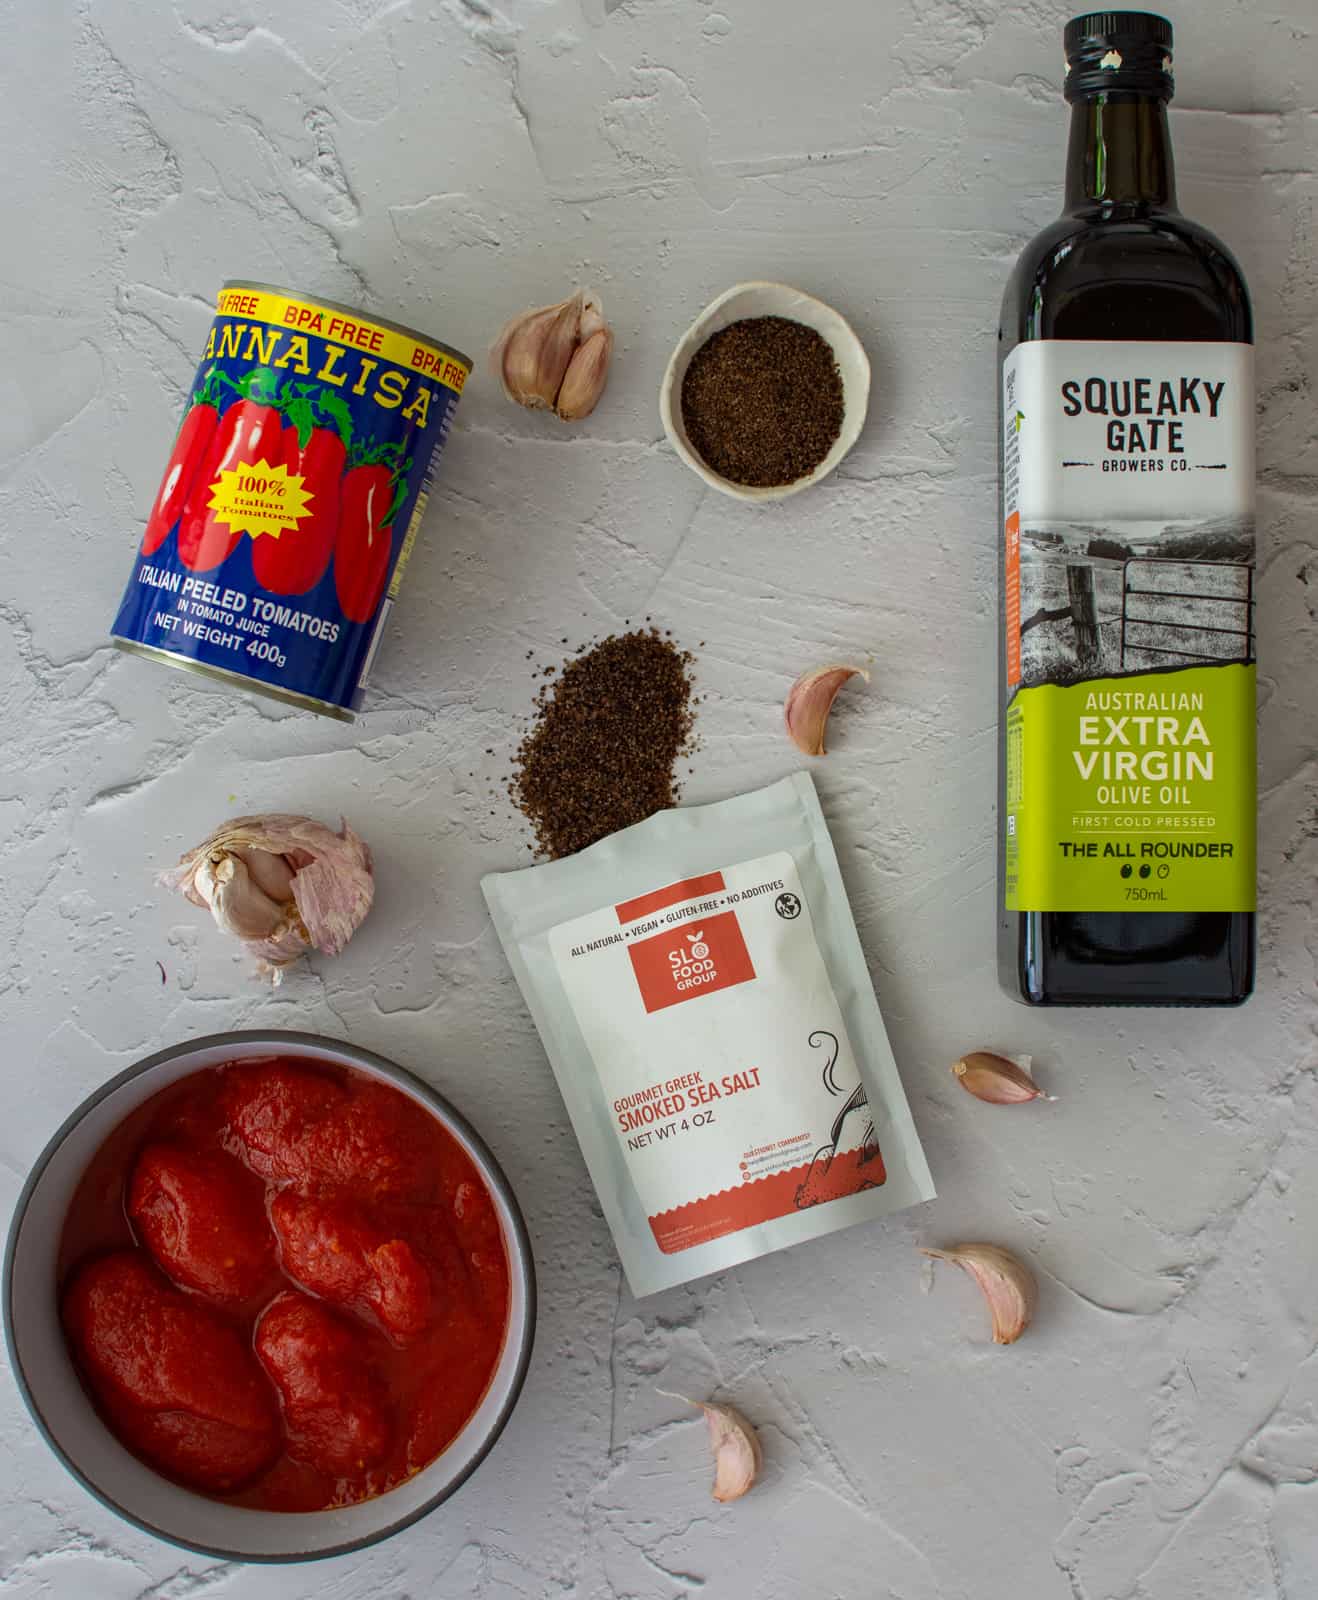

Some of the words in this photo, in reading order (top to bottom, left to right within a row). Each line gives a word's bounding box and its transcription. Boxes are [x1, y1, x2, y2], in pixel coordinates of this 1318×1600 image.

[225, 295, 259, 315] FREE
[283, 306, 322, 332] BPA
[327, 317, 384, 352] FREE
[201, 324, 432, 429] ANNALISA
[411, 348, 442, 377] BPA
[1061, 376, 1226, 417] SQUEAKY
[1107, 419, 1184, 453] GATE
[1102, 459, 1164, 472] GROWERS
[1171, 459, 1192, 471] CO.
[237, 476, 287, 497] 100%
[220, 506, 294, 521] Tomatoes
[234, 497, 284, 511] Italian
[138, 565, 182, 593] ITALIAN
[182, 577, 246, 612] PEELED
[251, 597, 340, 643] TOMATOES
[177, 599, 188, 612] IN
[191, 601, 234, 627] TOMATO
[235, 616, 271, 638] JUICE
[154, 612, 181, 630] NET
[183, 619, 244, 651] WEIGHT
[246, 640, 287, 668] 400g
[1085, 692, 1203, 711] AUSTRALIAN
[1079, 716, 1210, 746] EXTRA
[1072, 750, 1214, 781] VIRGIN
[1097, 785, 1151, 804] OLIVE
[1159, 785, 1192, 804] OIL
[1072, 816, 1108, 827] FIRST
[1114, 816, 1150, 827] COLD
[1157, 816, 1216, 827] PRESSED
[1059, 842, 1097, 857] THE
[1103, 842, 1136, 857] ALL
[1141, 842, 1234, 857] ROUNDER
[1125, 887, 1168, 901] 750mL
[570, 946, 585, 958] ALL
[586, 931, 624, 953] NATURAL
[631, 919, 659, 937] VEGAN
[665, 899, 719, 923] GLUTEN-FREE
[726, 894, 740, 905] NO
[741, 879, 784, 901] ADDITIVES
[672, 959, 714, 981] FOOD
[677, 970, 718, 991] GROUP
[614, 1085, 663, 1113] GOURMET
[665, 1071, 703, 1093] GREEK
[618, 1094, 686, 1133] SMOKED
[688, 1082, 721, 1108] SEA
[721, 1068, 761, 1096] SALT
[627, 1131, 652, 1151] NET
[654, 1123, 677, 1140] WT
[681, 1120, 689, 1131] 4
[692, 1110, 715, 1127] OZ
